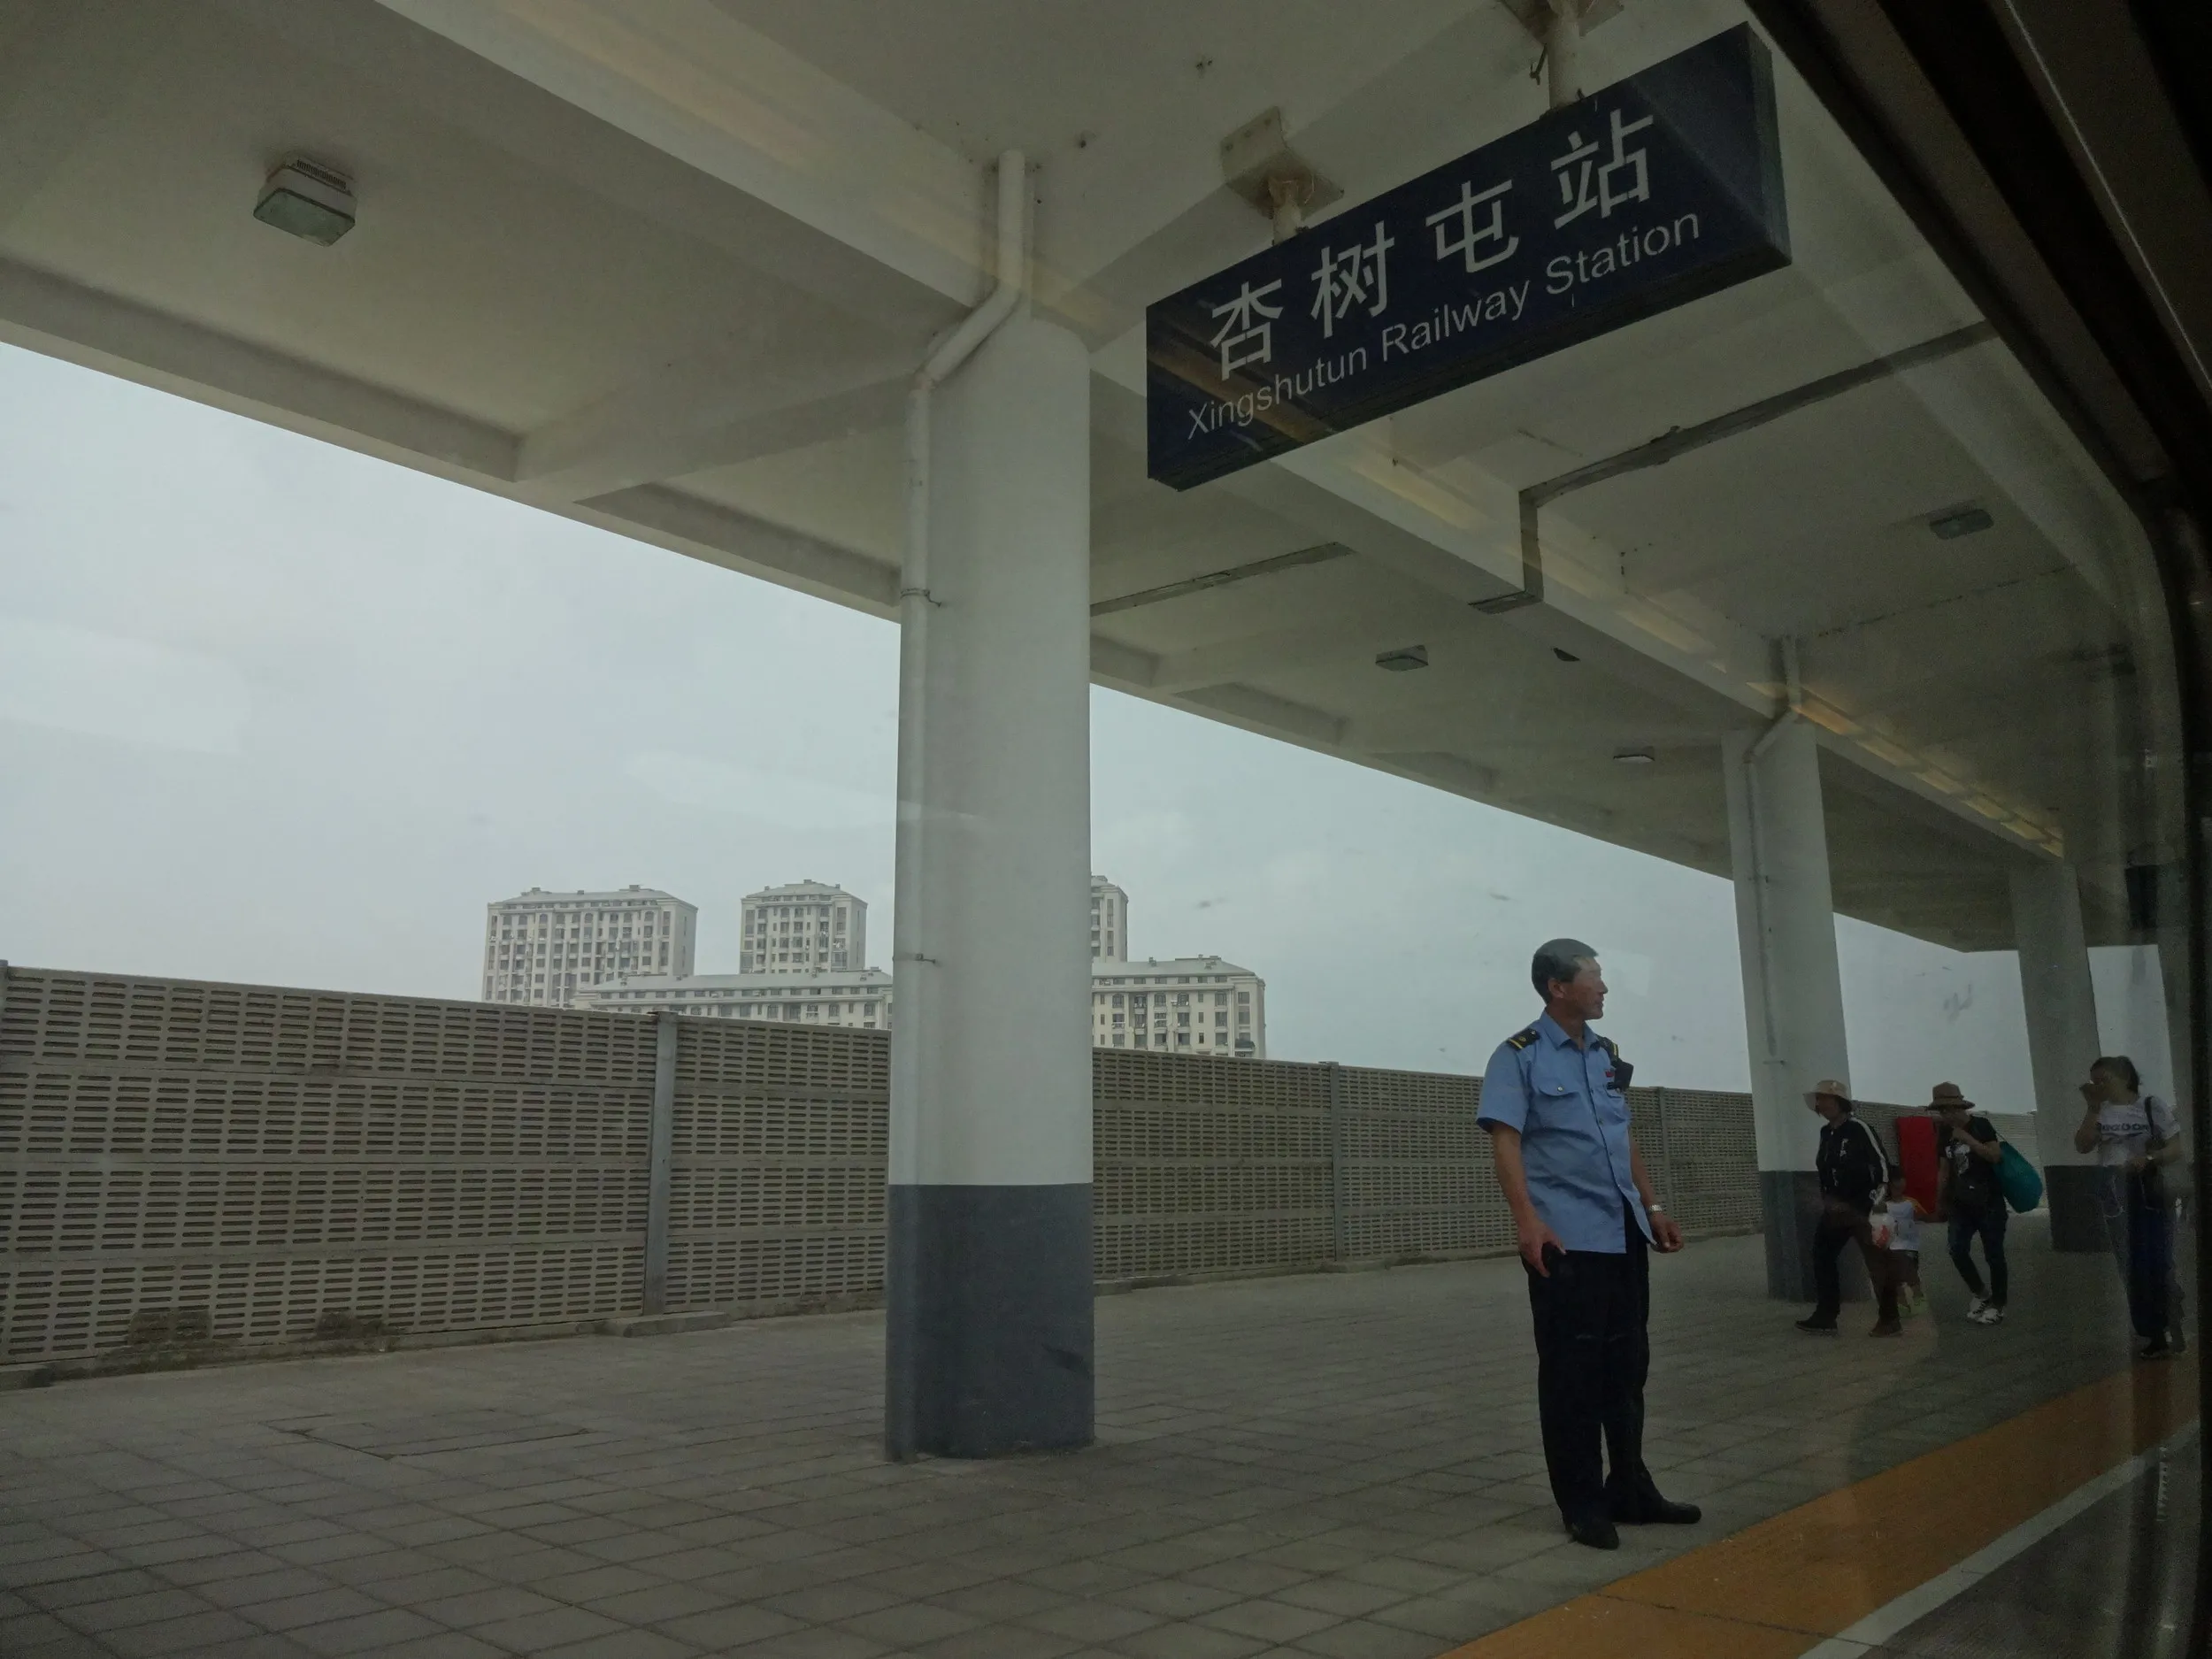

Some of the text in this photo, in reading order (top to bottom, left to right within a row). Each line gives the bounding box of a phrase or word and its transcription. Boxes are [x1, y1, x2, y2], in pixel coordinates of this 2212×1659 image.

[1187, 212, 1700, 441] Xingshutun Railway Station
[1210, 108, 1655, 381] 杏树屯站
